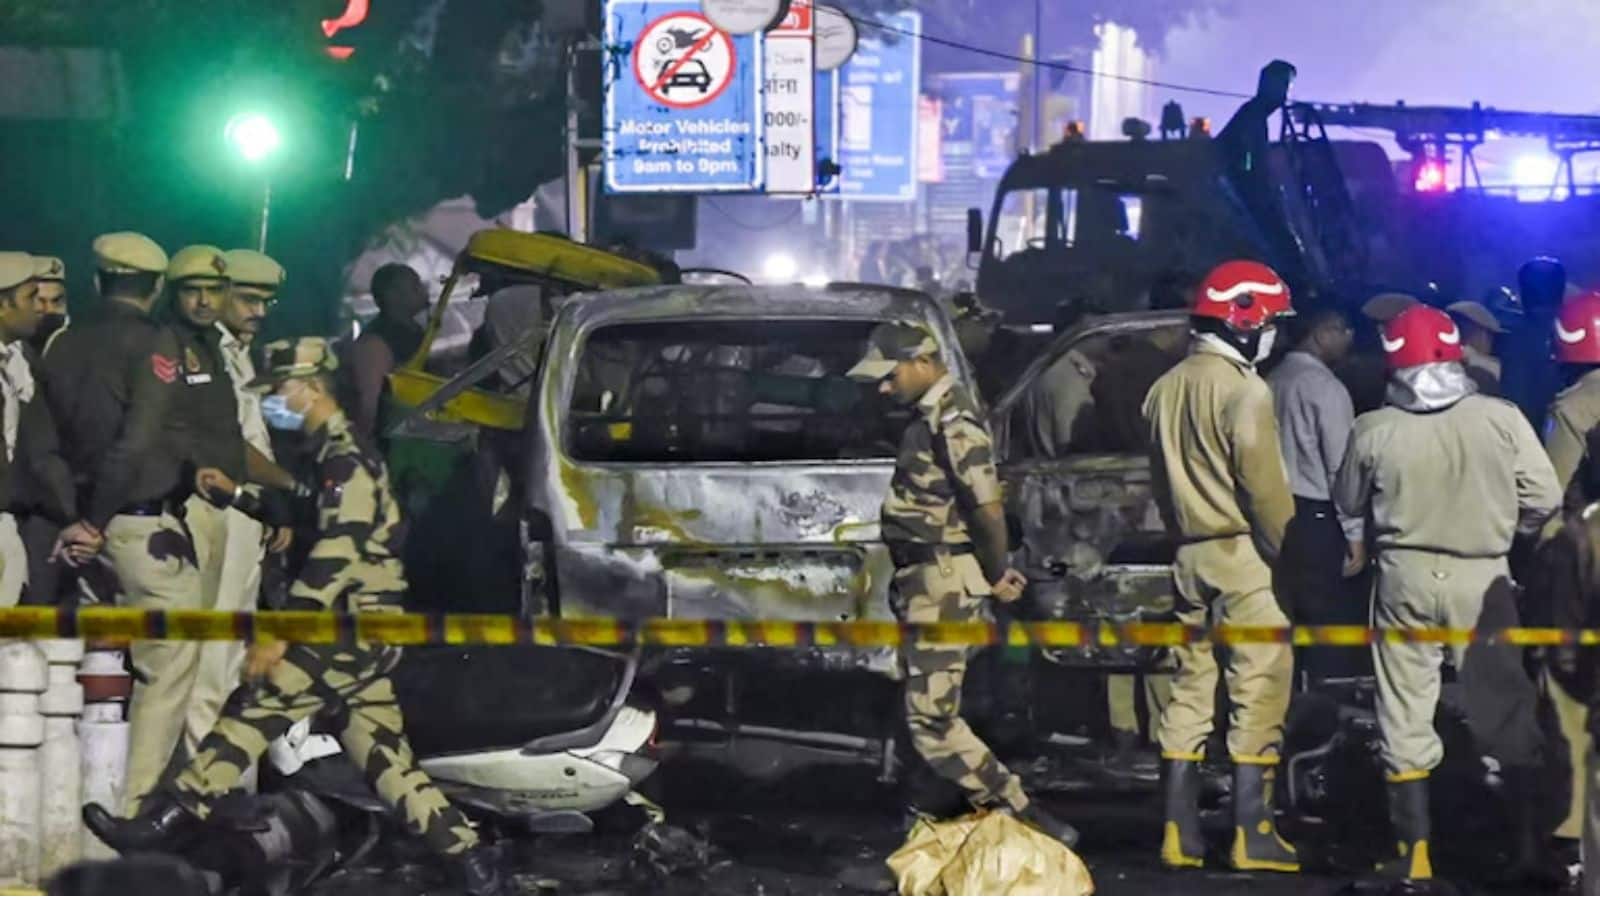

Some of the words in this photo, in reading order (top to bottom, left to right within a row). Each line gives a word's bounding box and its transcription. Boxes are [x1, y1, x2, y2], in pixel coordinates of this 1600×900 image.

[620, 120, 671, 135] Motor
[676, 119, 750, 134] Vehicles
[676, 159, 694, 174] to
